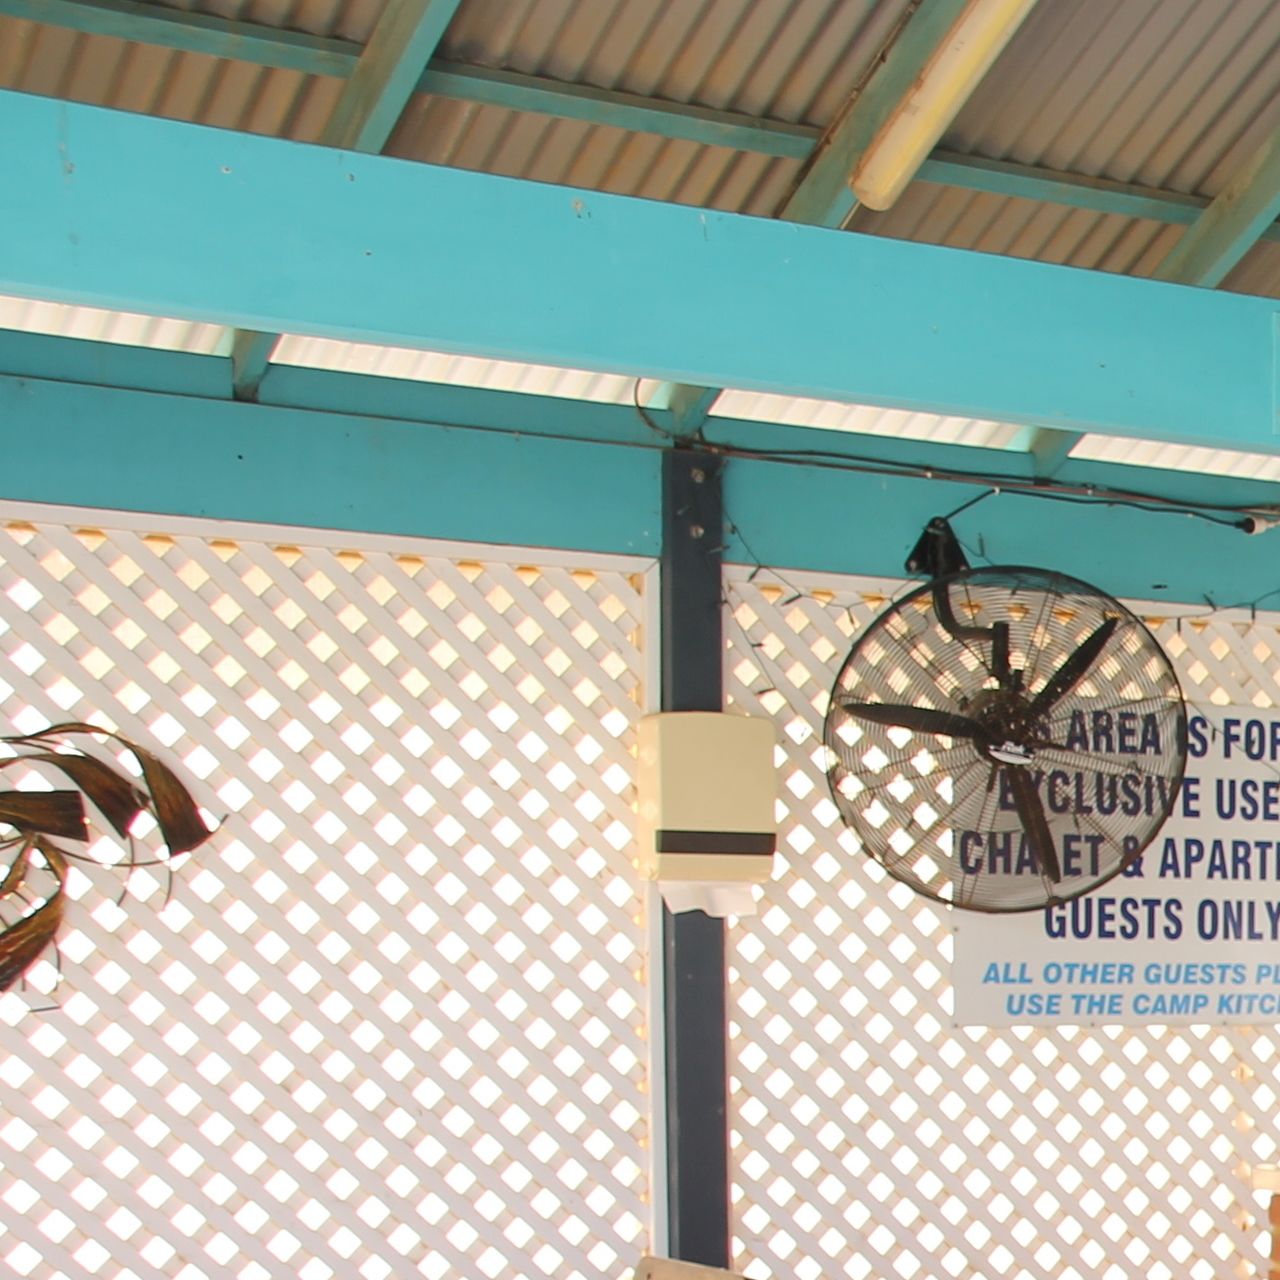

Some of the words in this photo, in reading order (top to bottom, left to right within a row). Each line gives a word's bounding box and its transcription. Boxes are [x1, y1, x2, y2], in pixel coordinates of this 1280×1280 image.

[1066, 710, 1161, 755] AREA
[1216, 778, 1280, 820] USE
[960, 830, 1104, 876] CHAET
[1120, 835, 1144, 878] &
[1044, 897, 1183, 940] GUESTS
[982, 962, 1033, 984] ALL
[1043, 962, 1135, 985] OTHER
[1143, 963, 1247, 986] GUESTS
[1006, 993, 1061, 1015] USE
[1071, 993, 1124, 1015] THE
[1132, 993, 1209, 1015] CAMP
